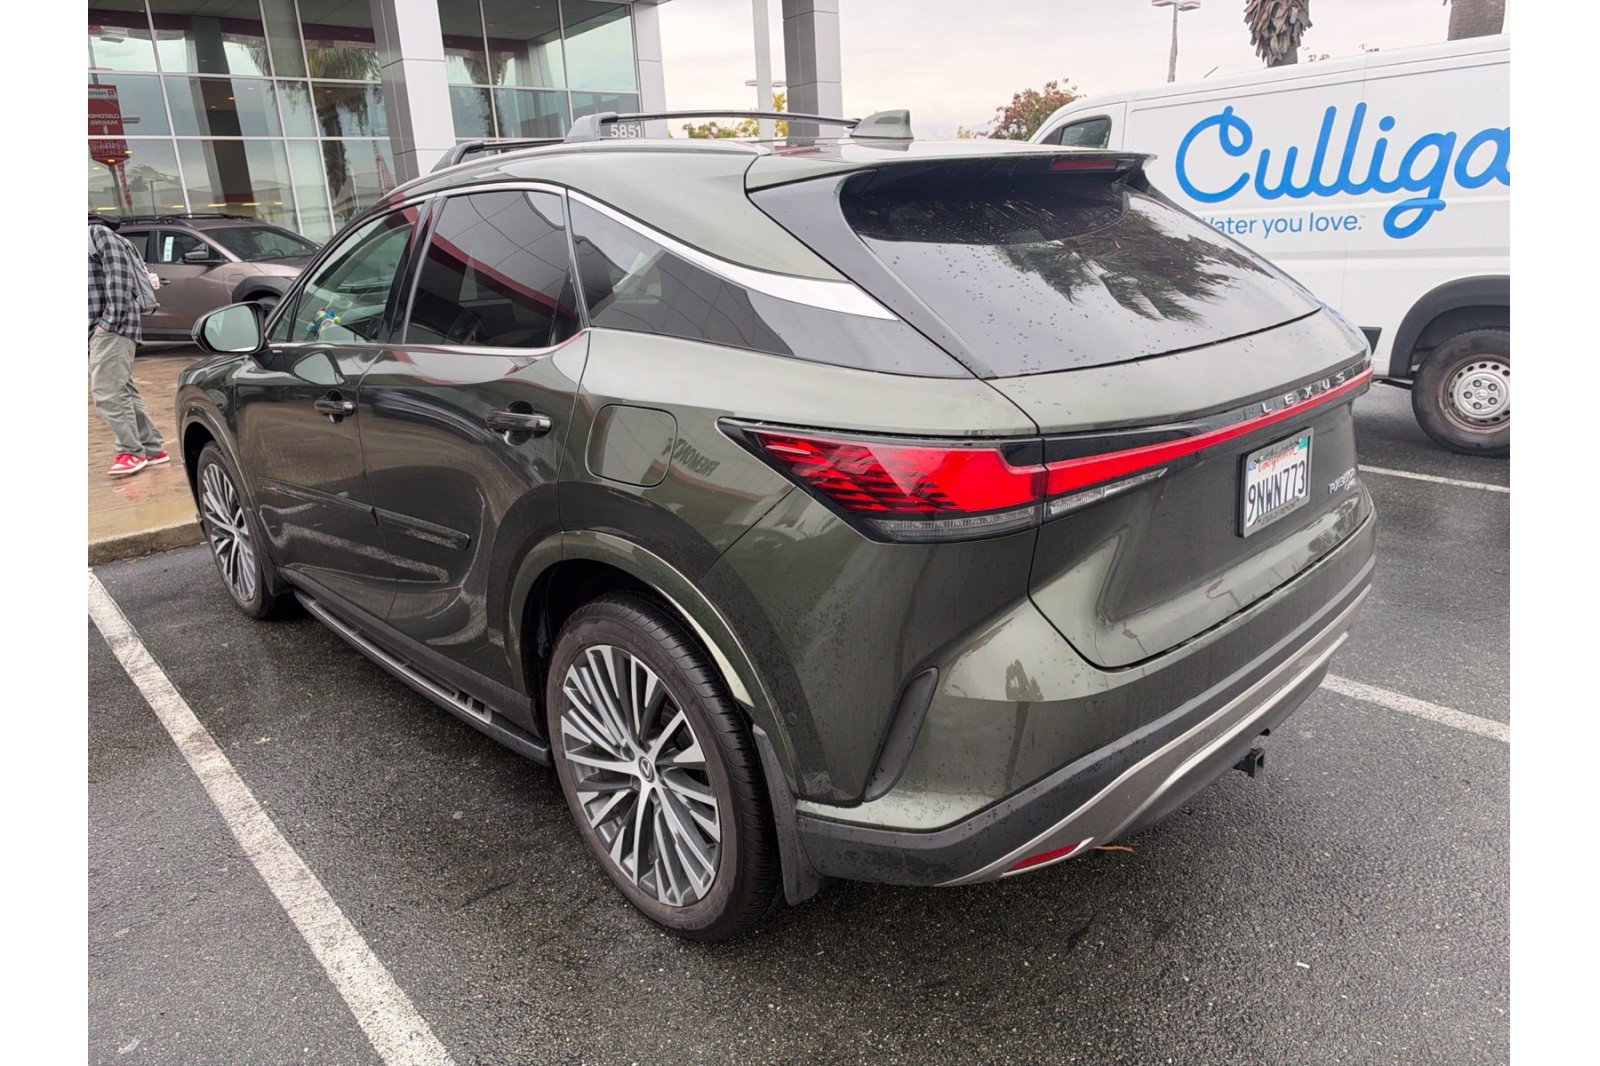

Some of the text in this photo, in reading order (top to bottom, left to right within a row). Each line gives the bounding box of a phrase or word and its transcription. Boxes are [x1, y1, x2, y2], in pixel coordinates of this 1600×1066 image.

[610, 124, 641, 138] 5851
[1202, 212, 1362, 239] ater you love.
[1261, 372, 1345, 413] LEXUS
[1247, 460, 1306, 523] 9NWN773
